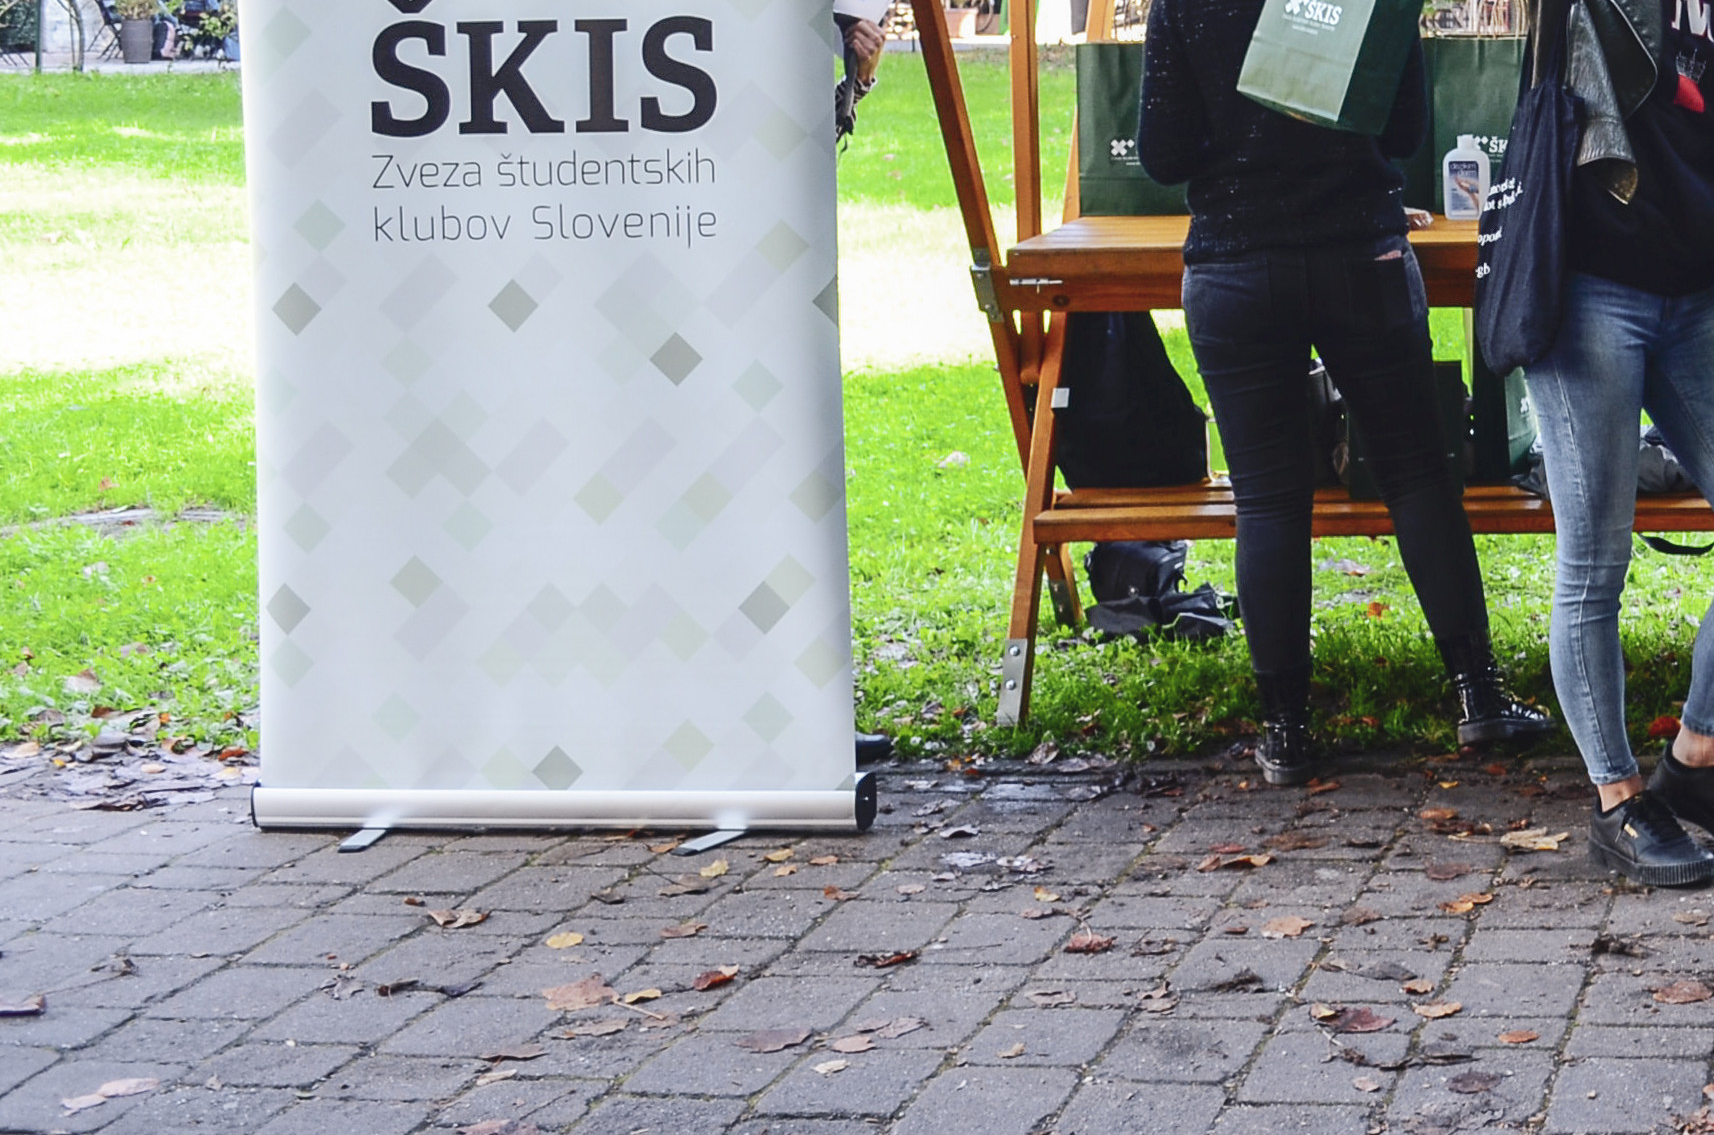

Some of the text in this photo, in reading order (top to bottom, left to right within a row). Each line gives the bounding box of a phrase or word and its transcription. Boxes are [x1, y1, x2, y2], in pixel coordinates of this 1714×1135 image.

[372, 148, 716, 190] Zveza študentskih
[374, 203, 718, 249] klubov Slovenije
